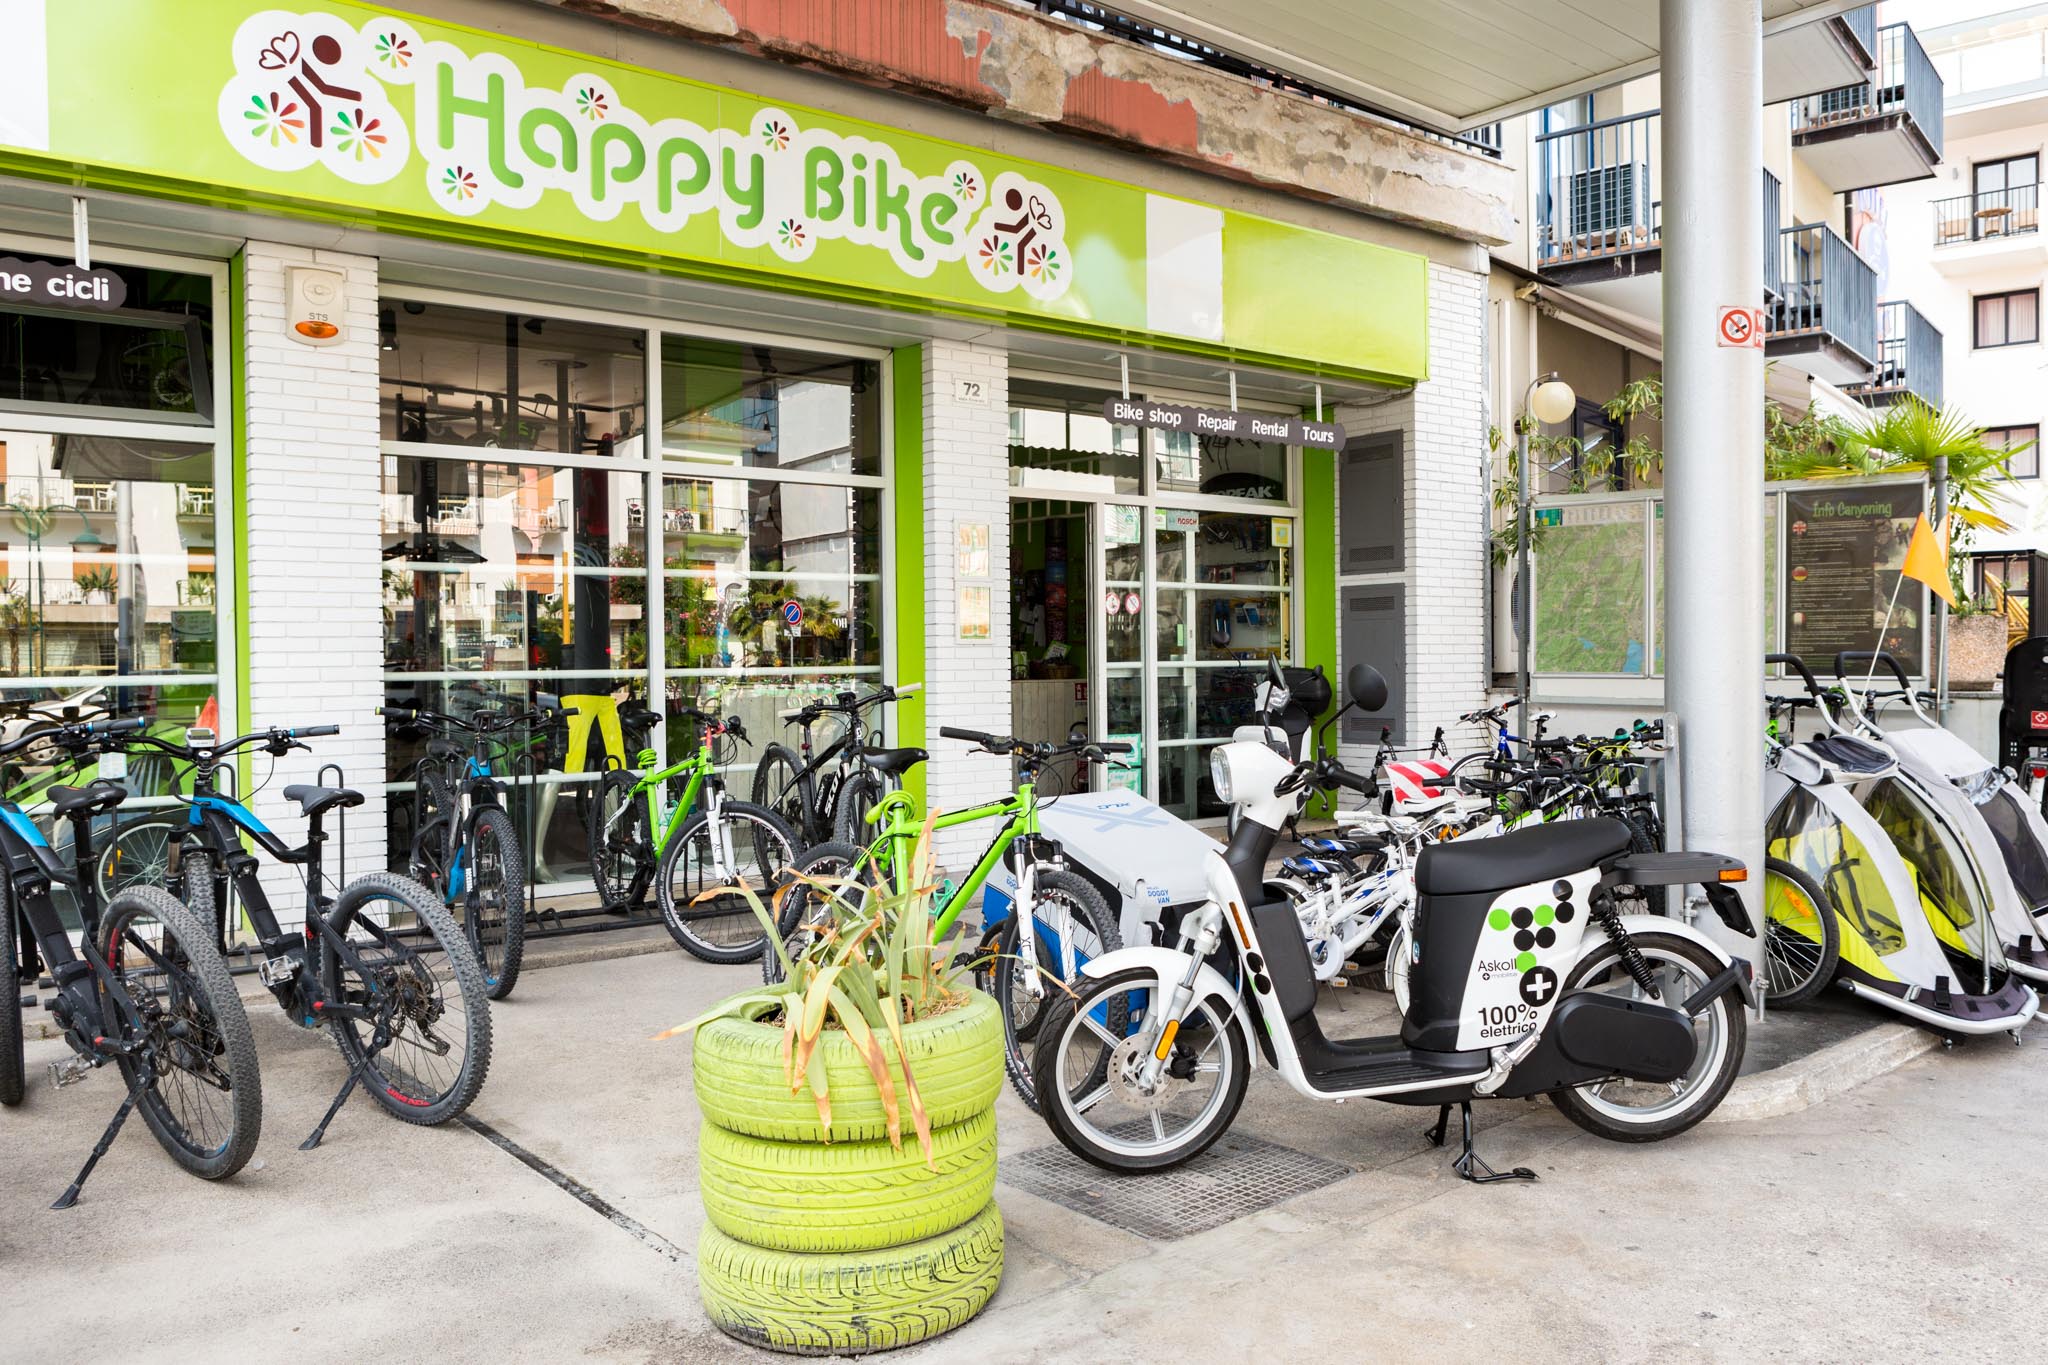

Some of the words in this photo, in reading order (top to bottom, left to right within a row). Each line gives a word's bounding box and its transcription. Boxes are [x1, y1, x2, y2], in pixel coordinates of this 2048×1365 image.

[437, 61, 764, 230] Happy
[804, 146, 958, 262] Bike
[46, 273, 109, 302] cicli
[308, 312, 329, 322] STS
[963, 382, 980, 397] 72
[1114, 403, 1144, 421] Bike
[1149, 408, 1182, 428] shop
[1198, 413, 1237, 432] Repair
[1252, 420, 1289, 438] Rental
[1302, 426, 1335, 444] Tours
[1813, 501, 1835, 518] Info
[1837, 501, 1893, 519] Canyoning
[1177, 517, 1198, 526] BOSCH
[824, 766, 842, 818] SCOT
[1157, 896, 1170, 904] VAN
[1478, 958, 1518, 973] Askoll
[1478, 1003, 1538, 1026] 100%
[1480, 1021, 1537, 1039] elettrico
